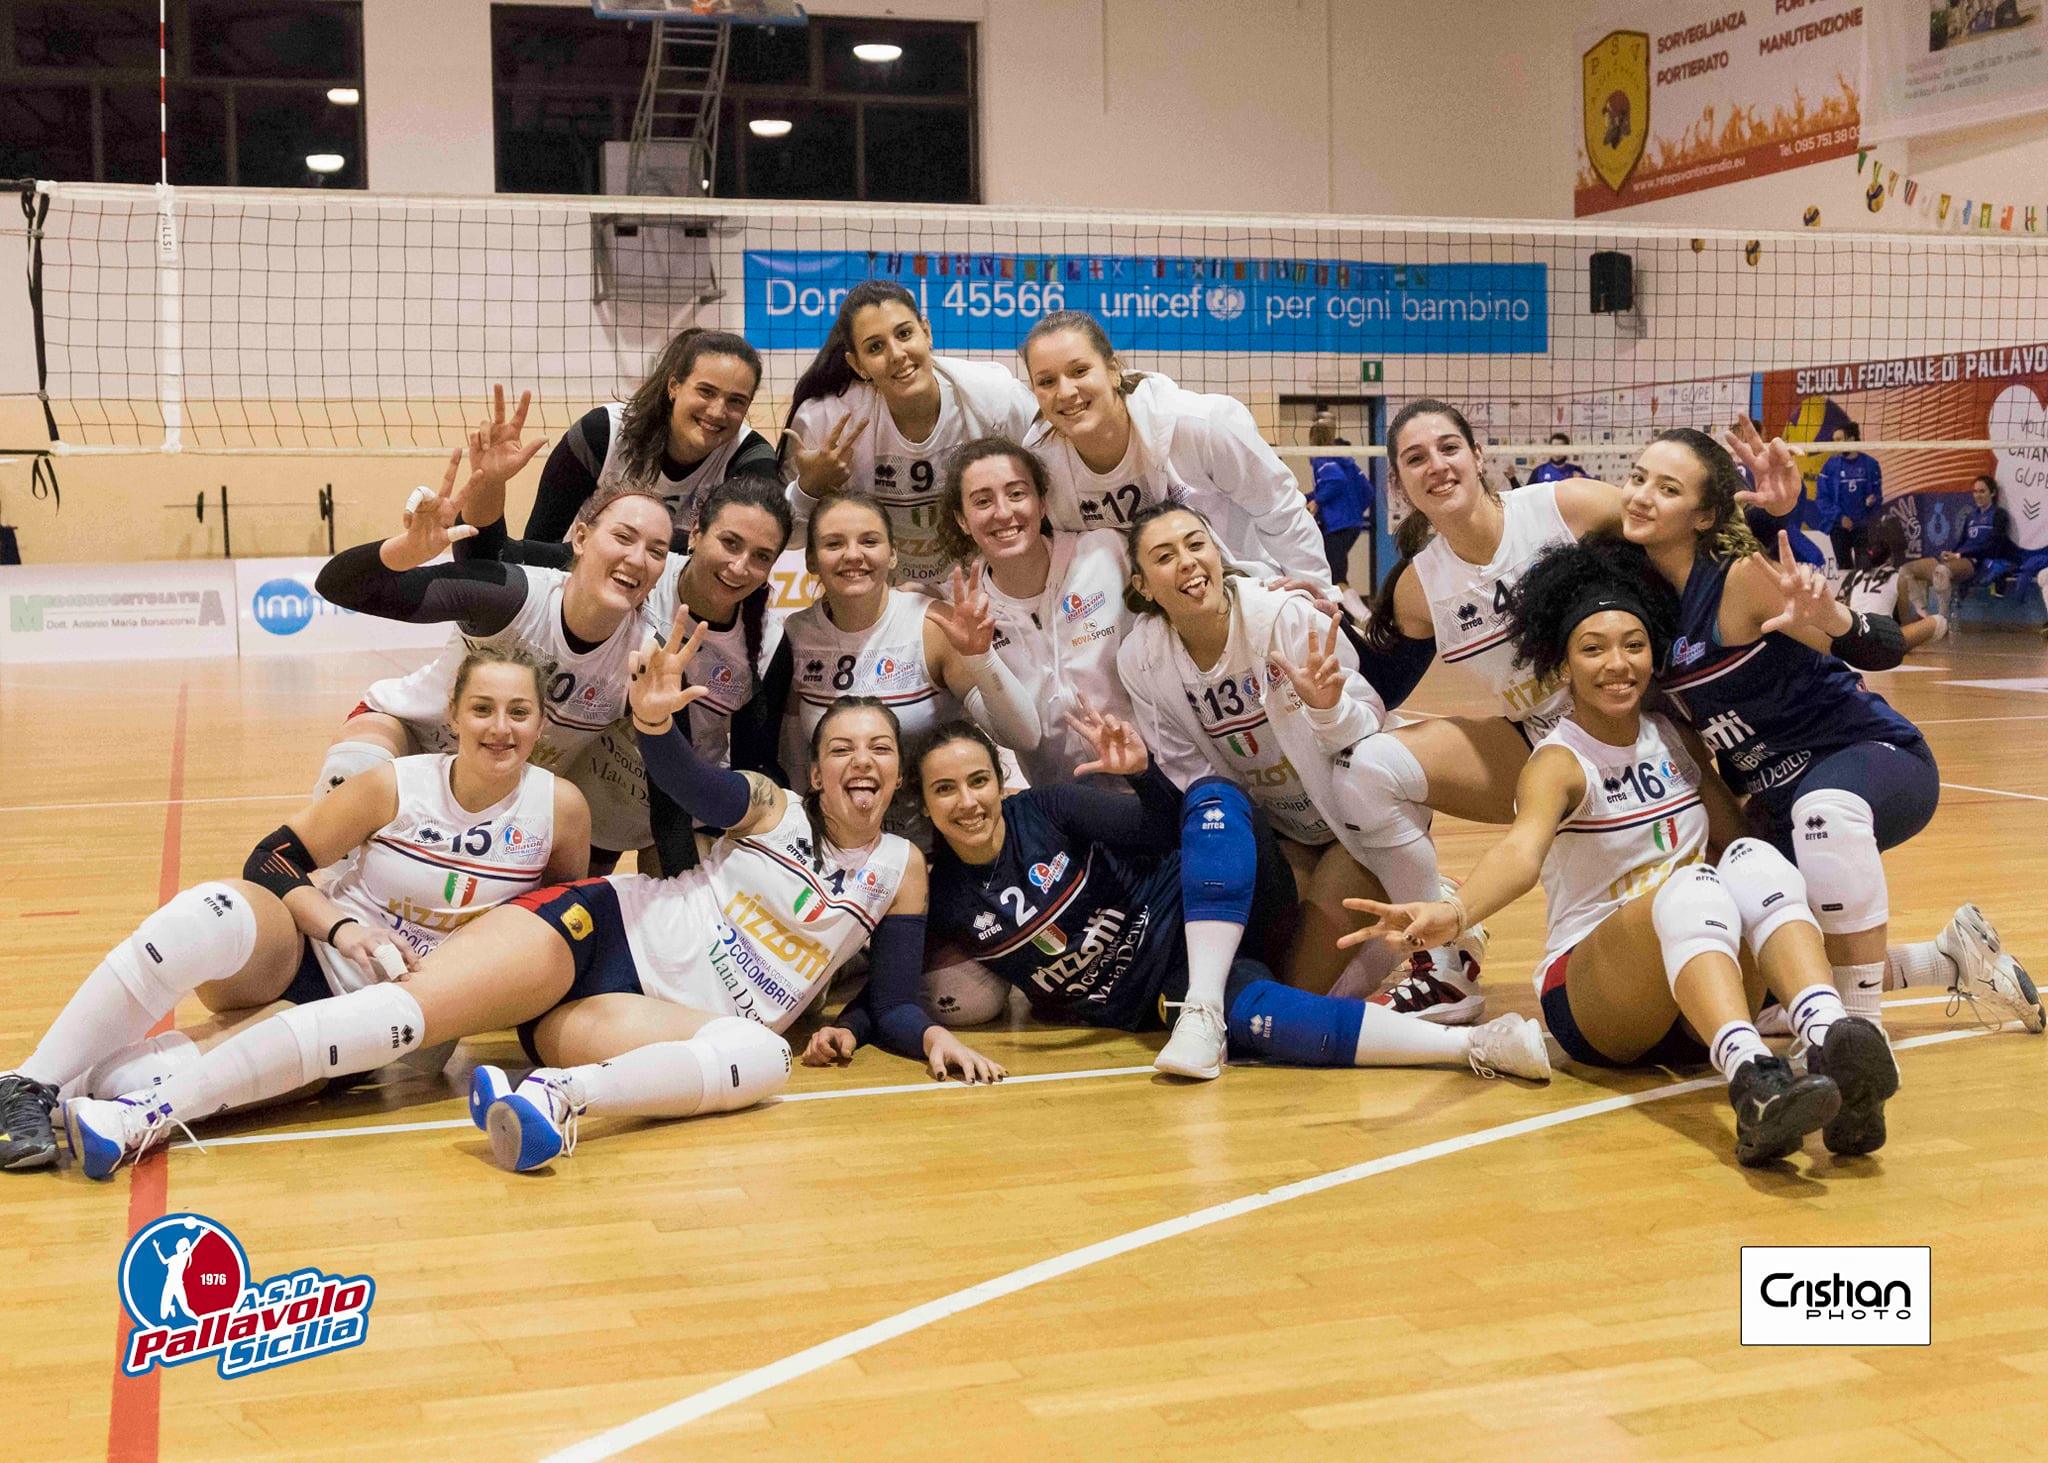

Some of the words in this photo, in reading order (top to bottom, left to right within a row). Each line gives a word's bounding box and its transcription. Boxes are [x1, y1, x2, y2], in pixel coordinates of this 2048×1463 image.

[1657, 10, 1748, 54] SORVEGLIANZA
[1759, 6, 1863, 56] MANUTENZIONE
[1657, 51, 1730, 86] PORTIERATO
[1816, 132, 1833, 148] 751
[1834, 128, 1848, 143] 38
[941, 280, 1066, 318] 45566
[1100, 285, 1204, 319] unicef
[1266, 293, 1317, 325] per
[1327, 289, 1392, 328] ogni
[1402, 291, 1530, 322] bambino
[1796, 369, 1853, 395] SCUOLA
[1857, 356, 1935, 390] FEDERALE
[1941, 352, 1958, 380] DI
[909, 460, 935, 493] 9
[1101, 483, 1142, 525] 12
[111, 614, 138, 628] Maria
[1071, 625, 1116, 648] NOVASPORT
[1461, 616, 1484, 632] errea
[832, 655, 857, 691] 8
[1203, 679, 1245, 721] 13
[1606, 791, 1628, 804] errea
[1620, 762, 1666, 804] 16
[451, 820, 493, 857] 15
[1201, 821, 1225, 830] errea
[1804, 830, 1829, 841] errea
[785, 843, 808, 866] errea
[203, 896, 224, 918] errea
[999, 886, 1039, 928] 2
[978, 923, 1003, 942] errea
[390, 1025, 400, 1050] errea
[1262, 1015, 1273, 1038] errea
